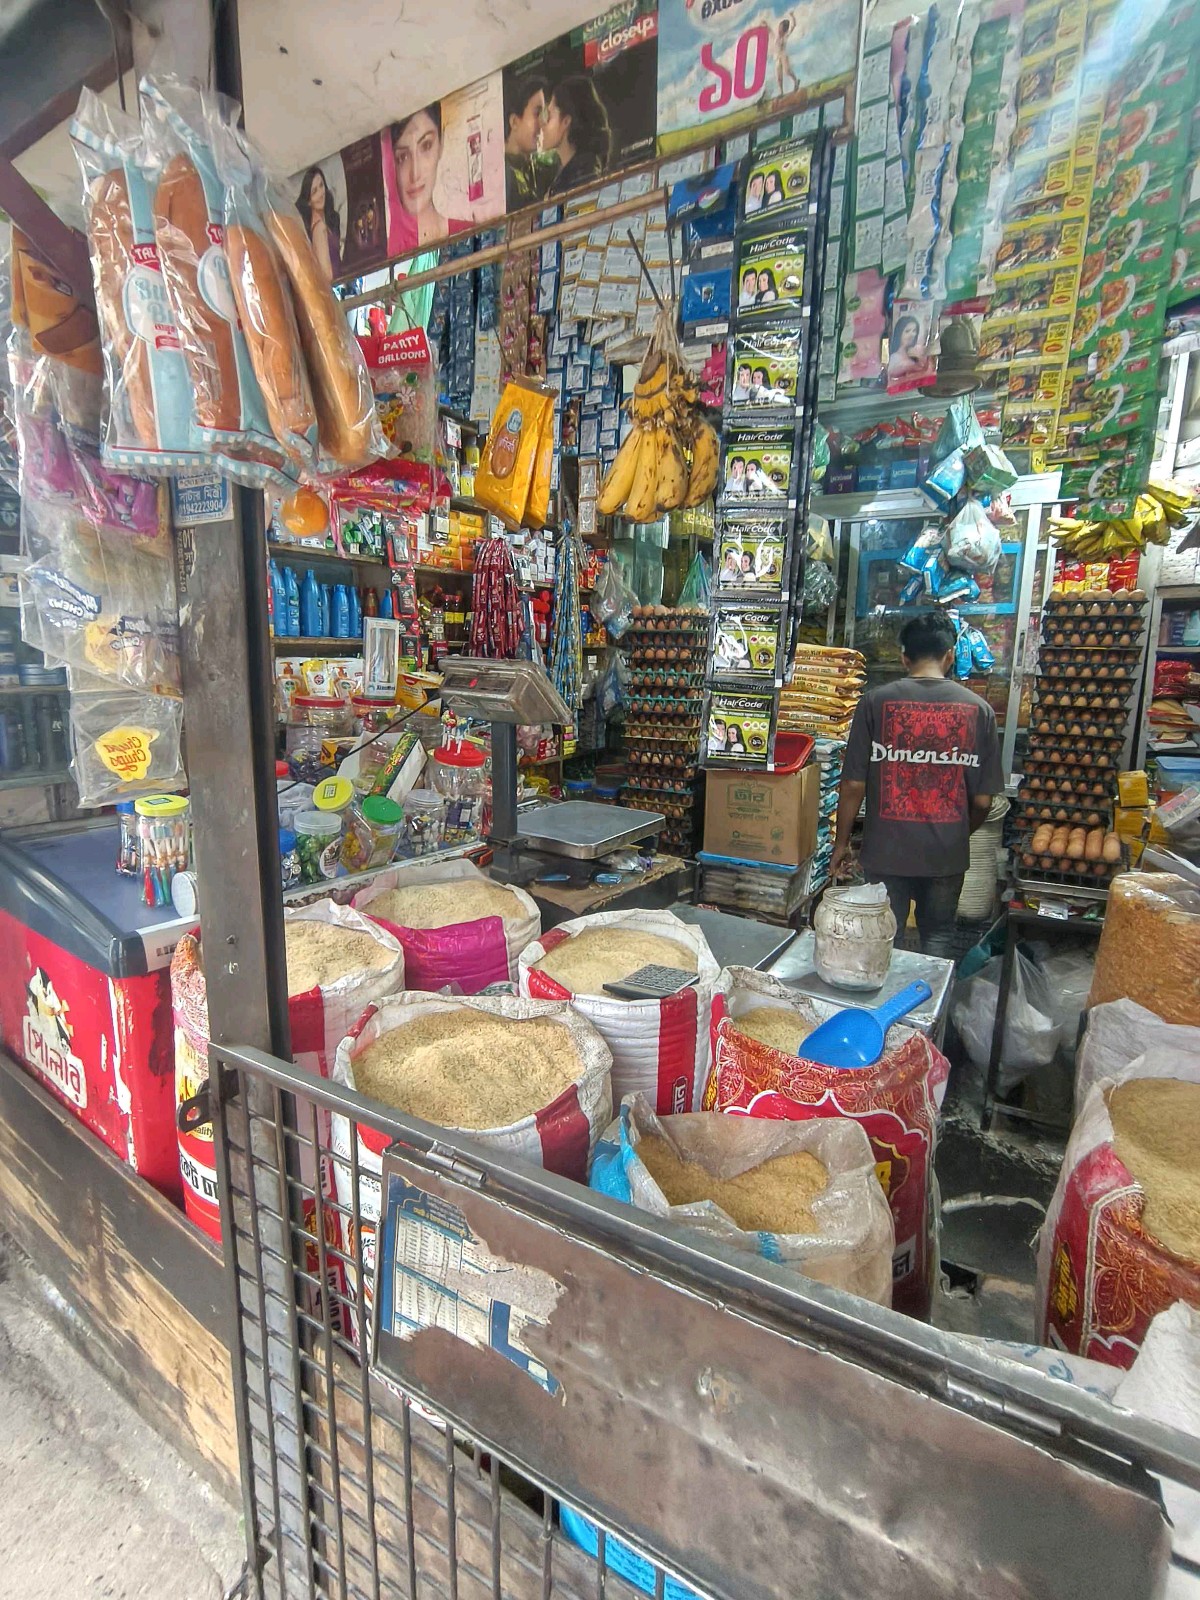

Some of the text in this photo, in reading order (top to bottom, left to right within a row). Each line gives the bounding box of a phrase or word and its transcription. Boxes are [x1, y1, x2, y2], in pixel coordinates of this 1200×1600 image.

[600, 17, 655, 52] closeup
[749, 236, 796, 254] HairCode
[383, 334, 419, 351] PARTY
[378, 349, 427, 364] BALLOONS
[738, 432, 784, 442] HairCode
[731, 524, 776, 534] HairCode
[720, 698, 763, 709] HairCode
[870, 740, 980, 768] Dimension
